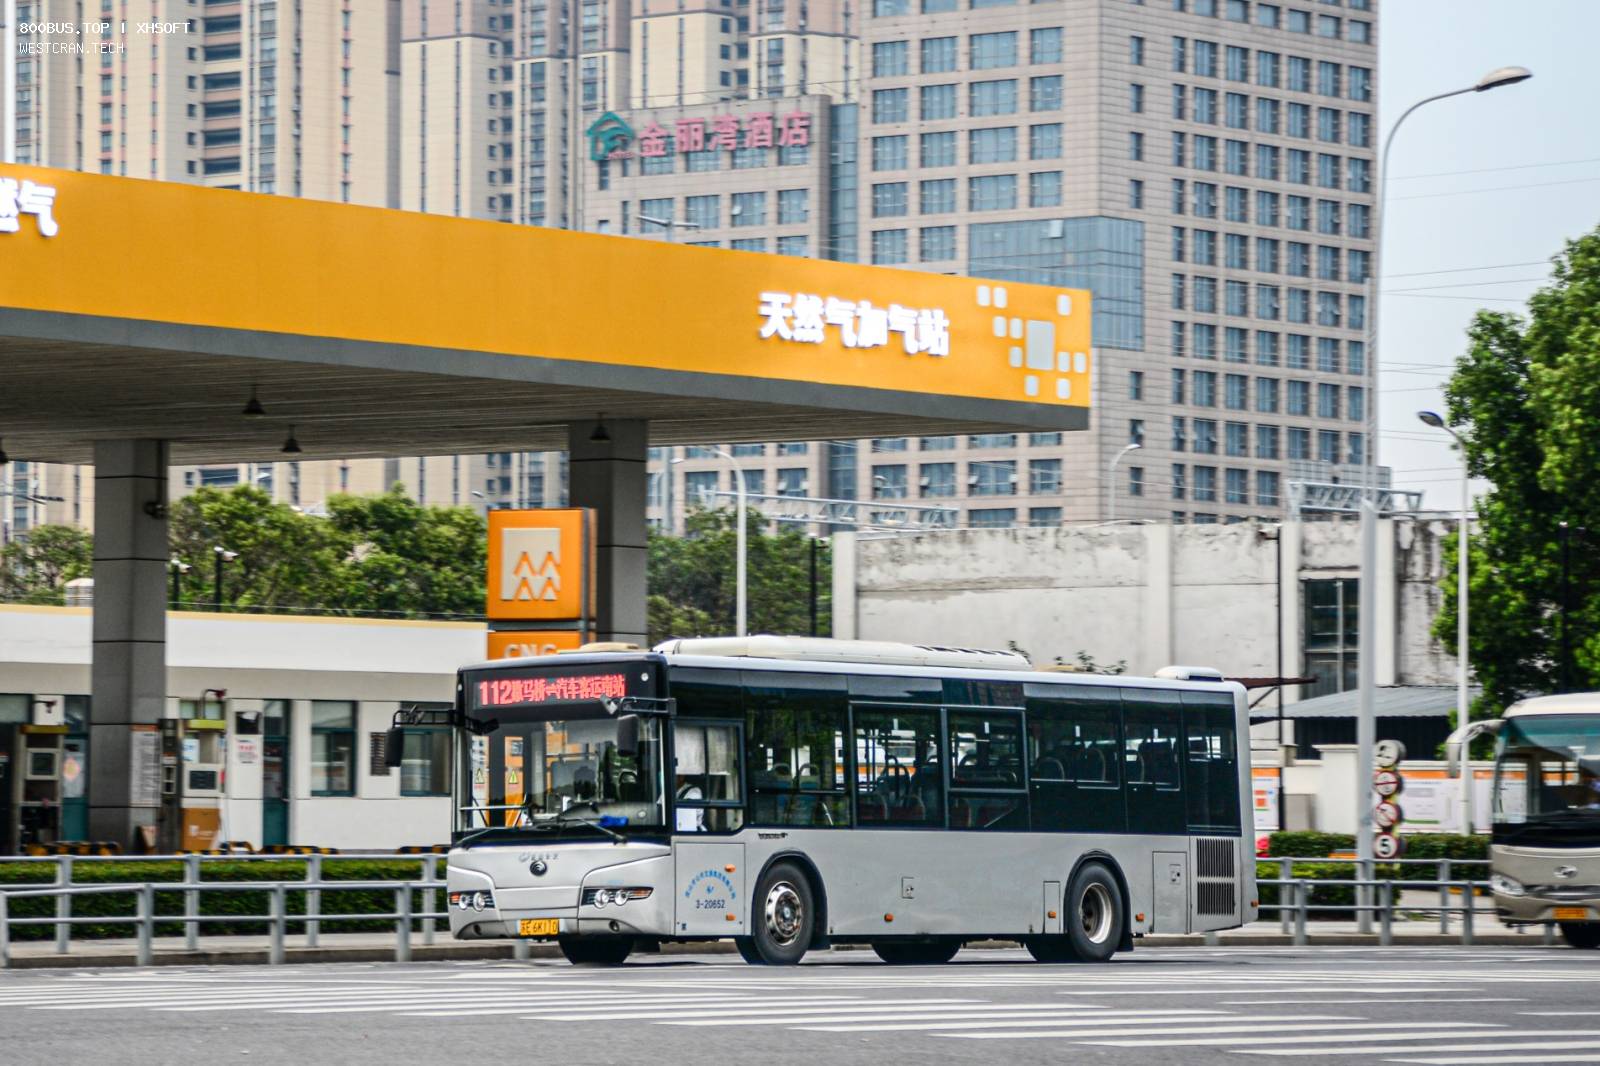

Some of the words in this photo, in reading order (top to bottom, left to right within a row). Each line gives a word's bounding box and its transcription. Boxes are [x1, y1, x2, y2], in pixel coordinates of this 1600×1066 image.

[638, 110, 812, 157] 金丽湾酒店
[759, 291, 950, 356] 天然气加气站
[1380, 838, 1391, 855] 5
